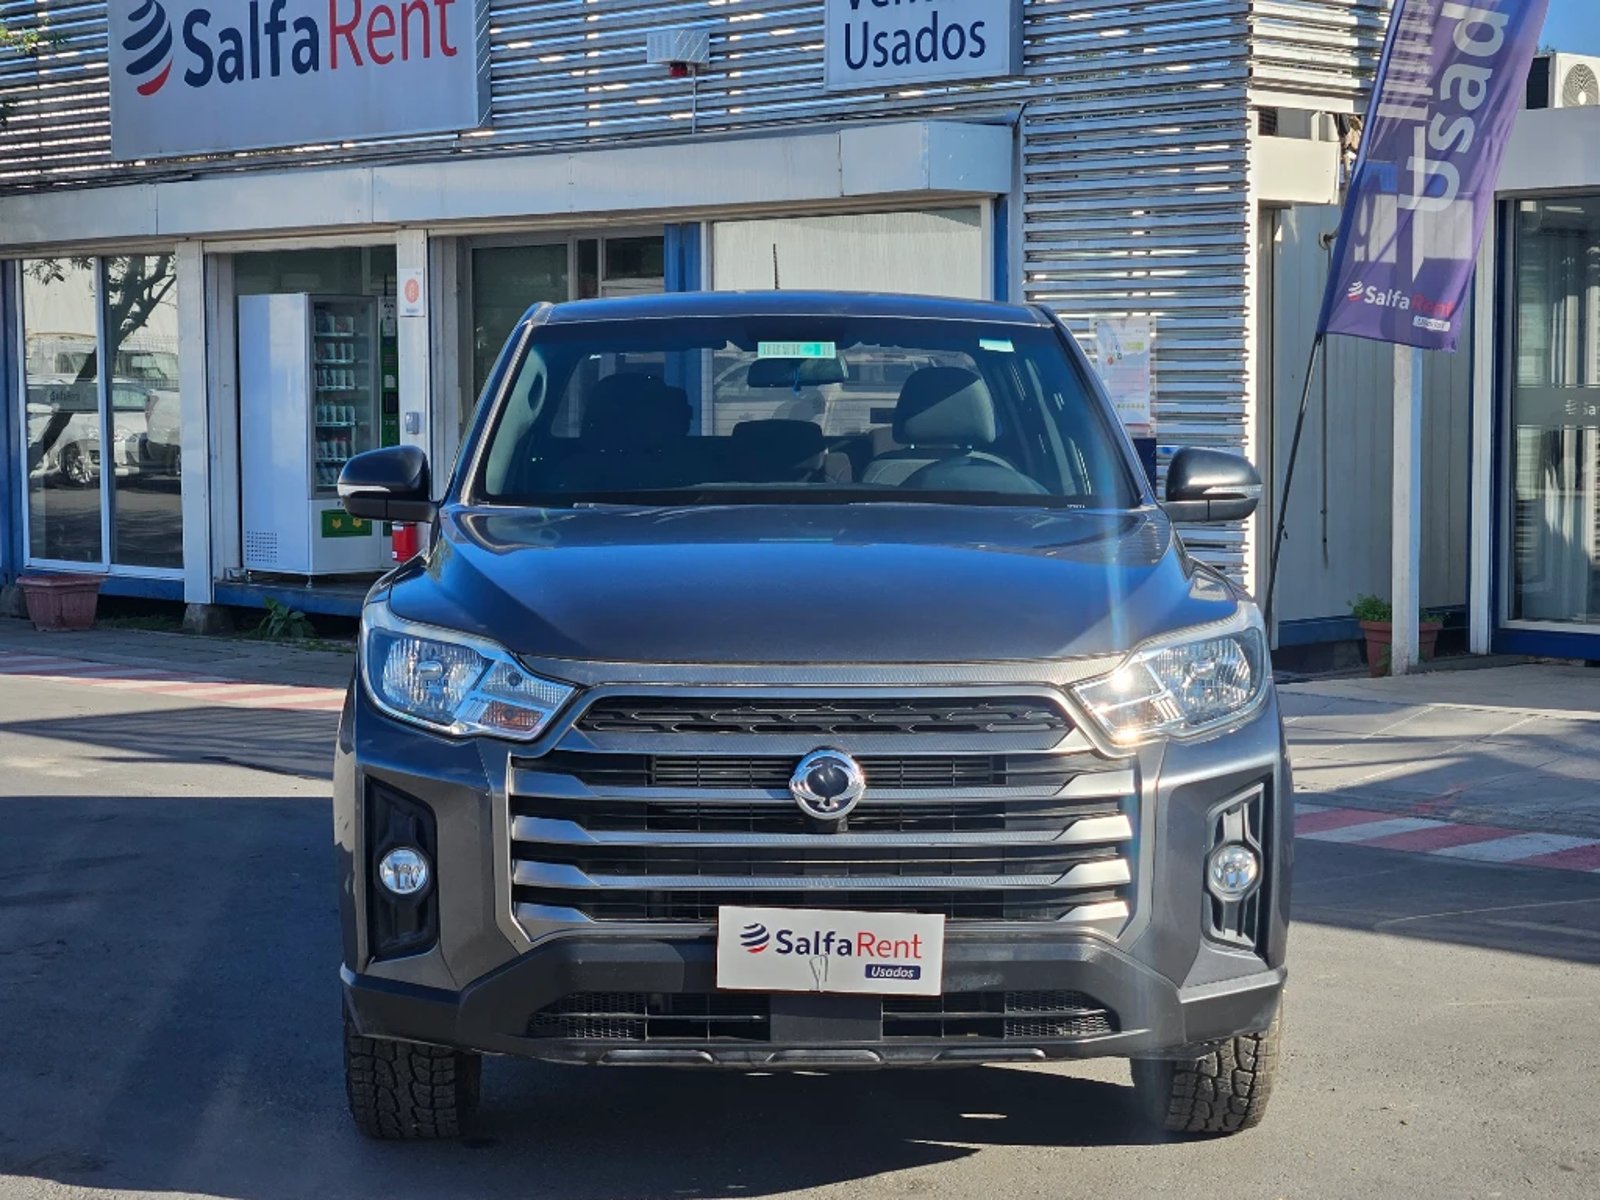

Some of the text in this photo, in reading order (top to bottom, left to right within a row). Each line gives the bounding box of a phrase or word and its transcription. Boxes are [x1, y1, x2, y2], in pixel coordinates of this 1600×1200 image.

[182, 0, 458, 88] SalfaRent
[844, 11, 986, 70] Usados
[775, 929, 922, 959] SalfaRent
[871, 965, 915, 979] Usados
